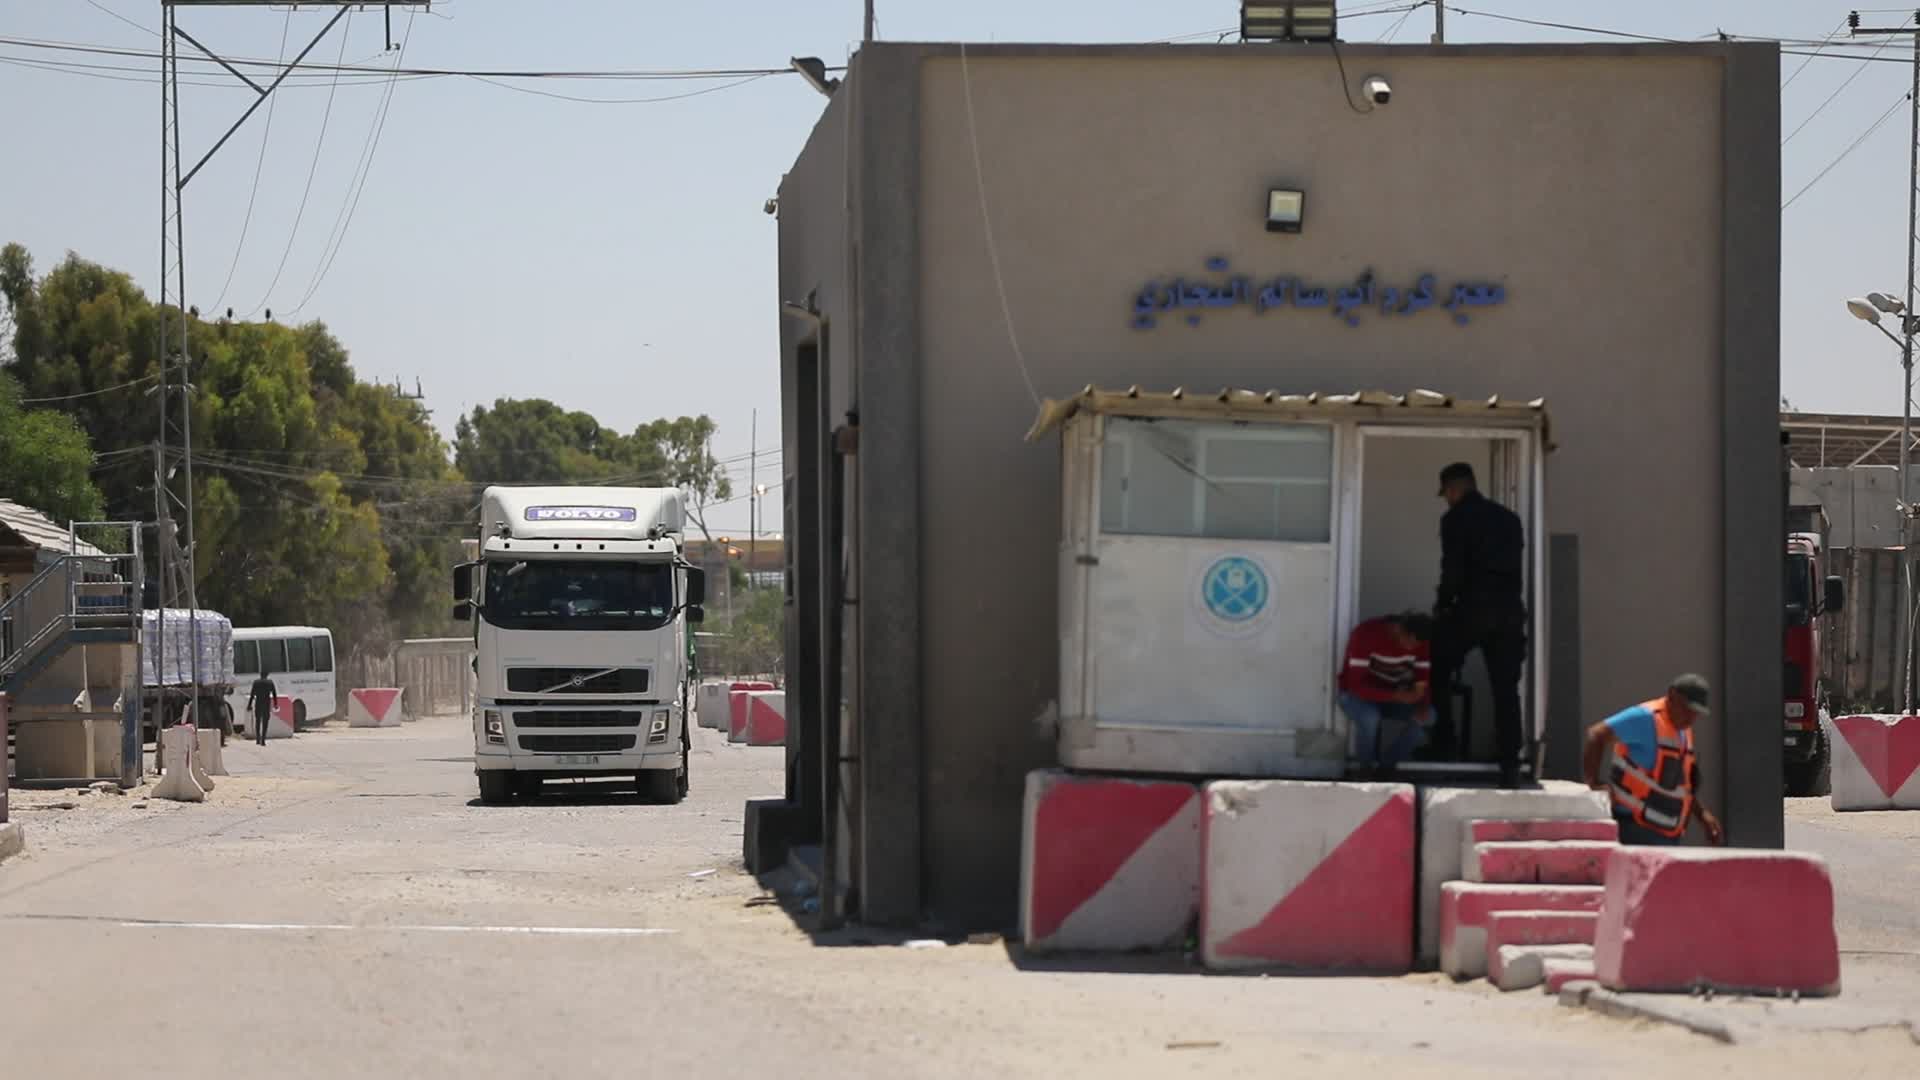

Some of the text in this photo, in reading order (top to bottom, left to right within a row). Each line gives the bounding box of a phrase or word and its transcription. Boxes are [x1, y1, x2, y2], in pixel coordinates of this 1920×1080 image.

[1131, 257, 1506, 329] معبر كرم أبو سالم التجاري
[537, 509, 621, 519] VOLVO
